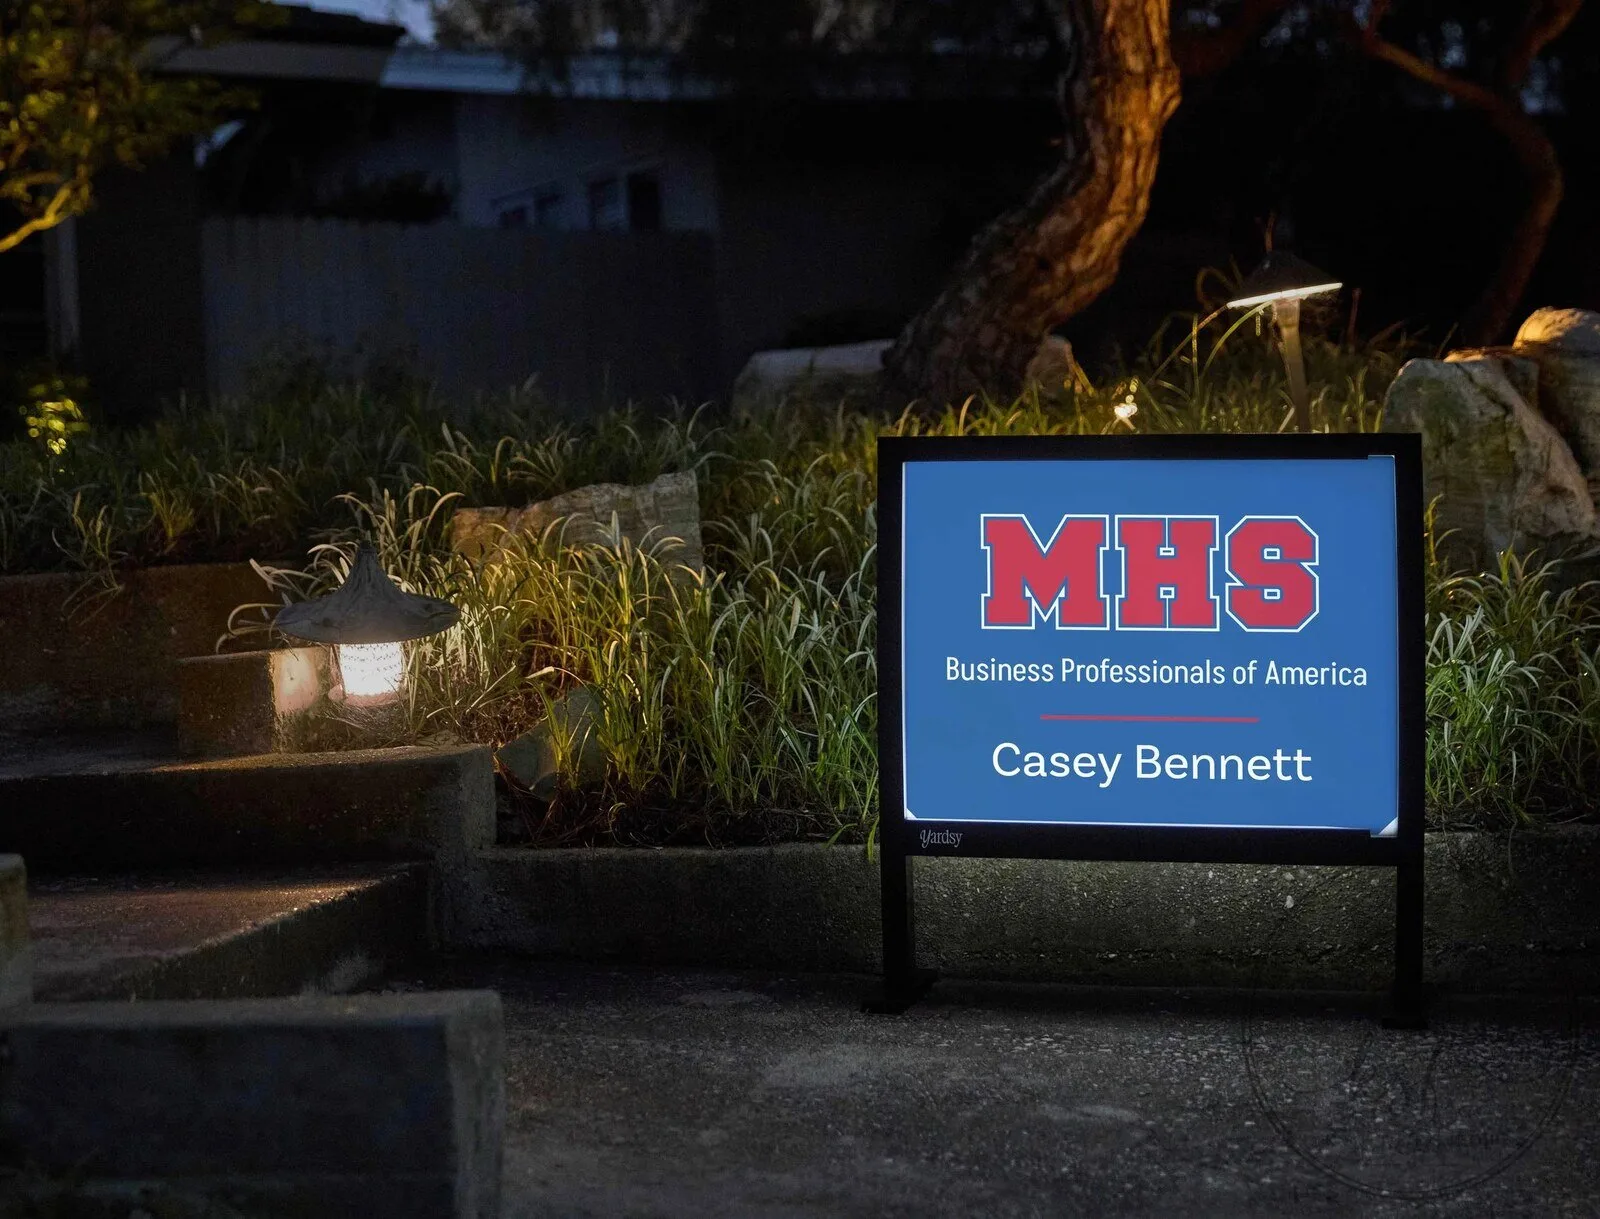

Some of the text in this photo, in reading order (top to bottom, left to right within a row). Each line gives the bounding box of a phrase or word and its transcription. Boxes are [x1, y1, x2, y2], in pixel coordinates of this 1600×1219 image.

[981, 514, 1319, 632] MHS
[946, 656, 1367, 686] Business Professionals of America
[992, 742, 1312, 788] Casey Bennett
[920, 829, 963, 849] Yardsy
